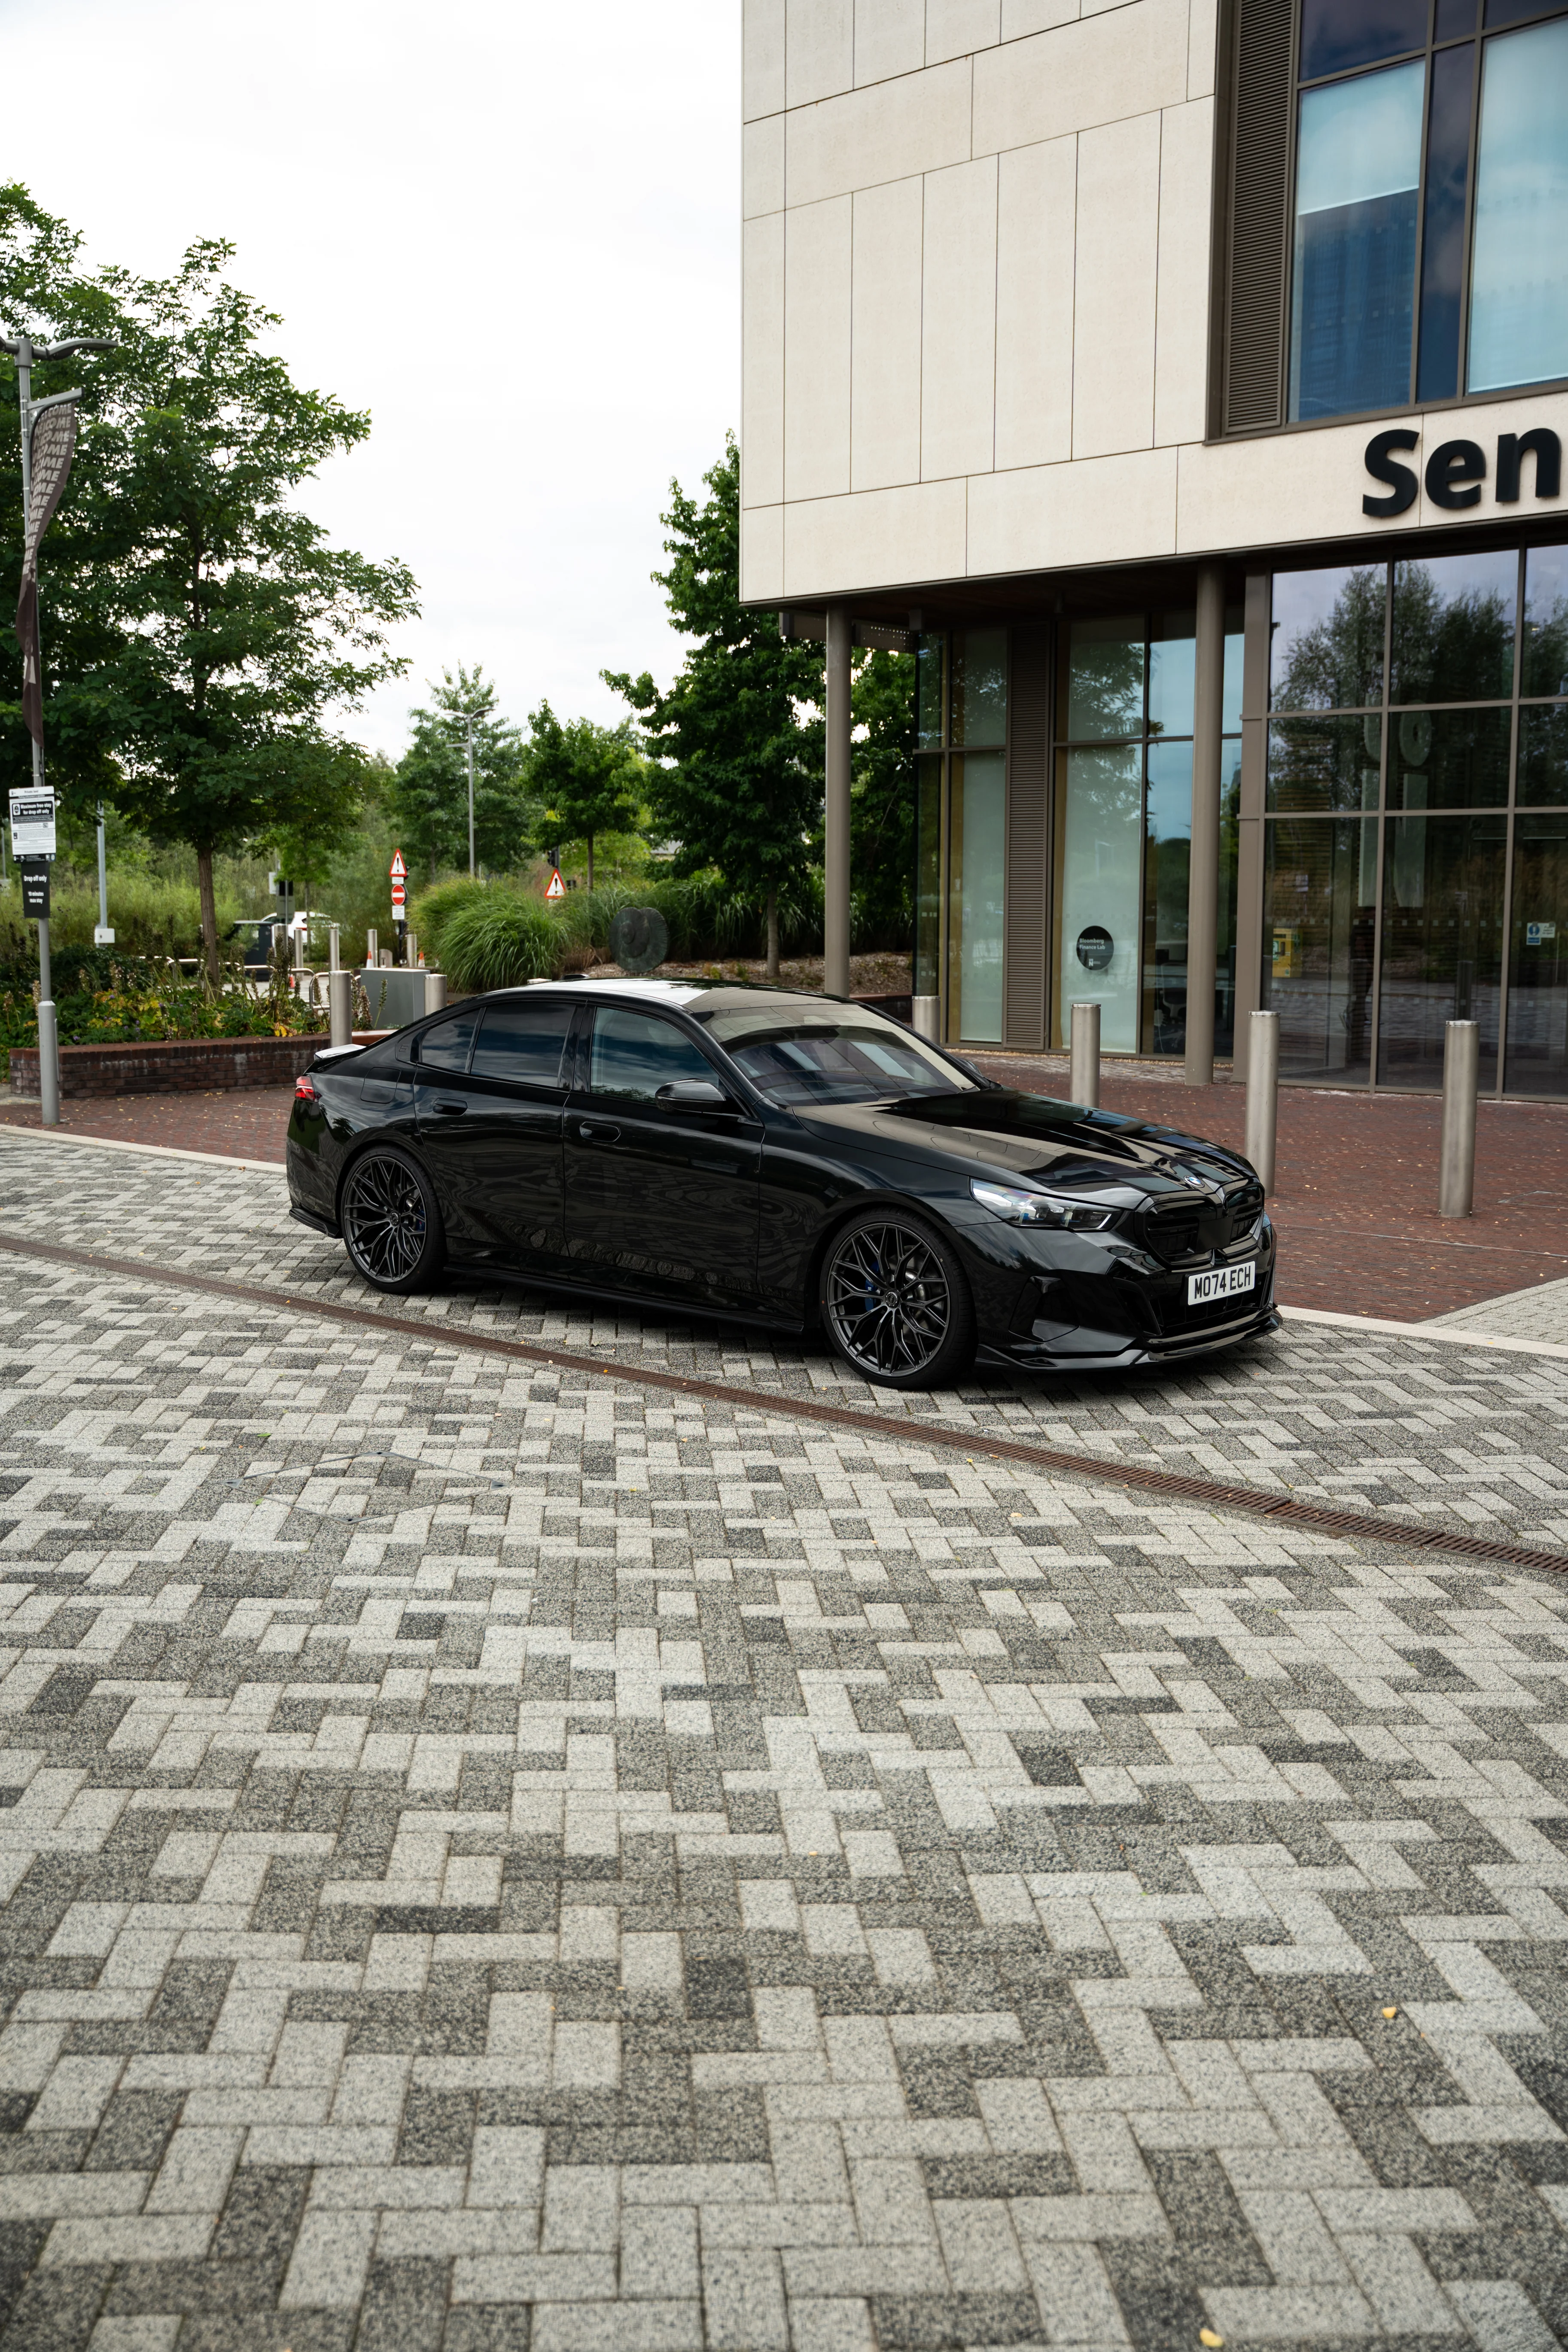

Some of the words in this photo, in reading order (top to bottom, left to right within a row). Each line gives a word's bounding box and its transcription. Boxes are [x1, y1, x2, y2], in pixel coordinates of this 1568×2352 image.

[1362, 428, 1562, 517] Sen
[39, 875, 47, 883] only
[1194, 1272, 1227, 1299] MO74
[1230, 1266, 1251, 1291] ECH
